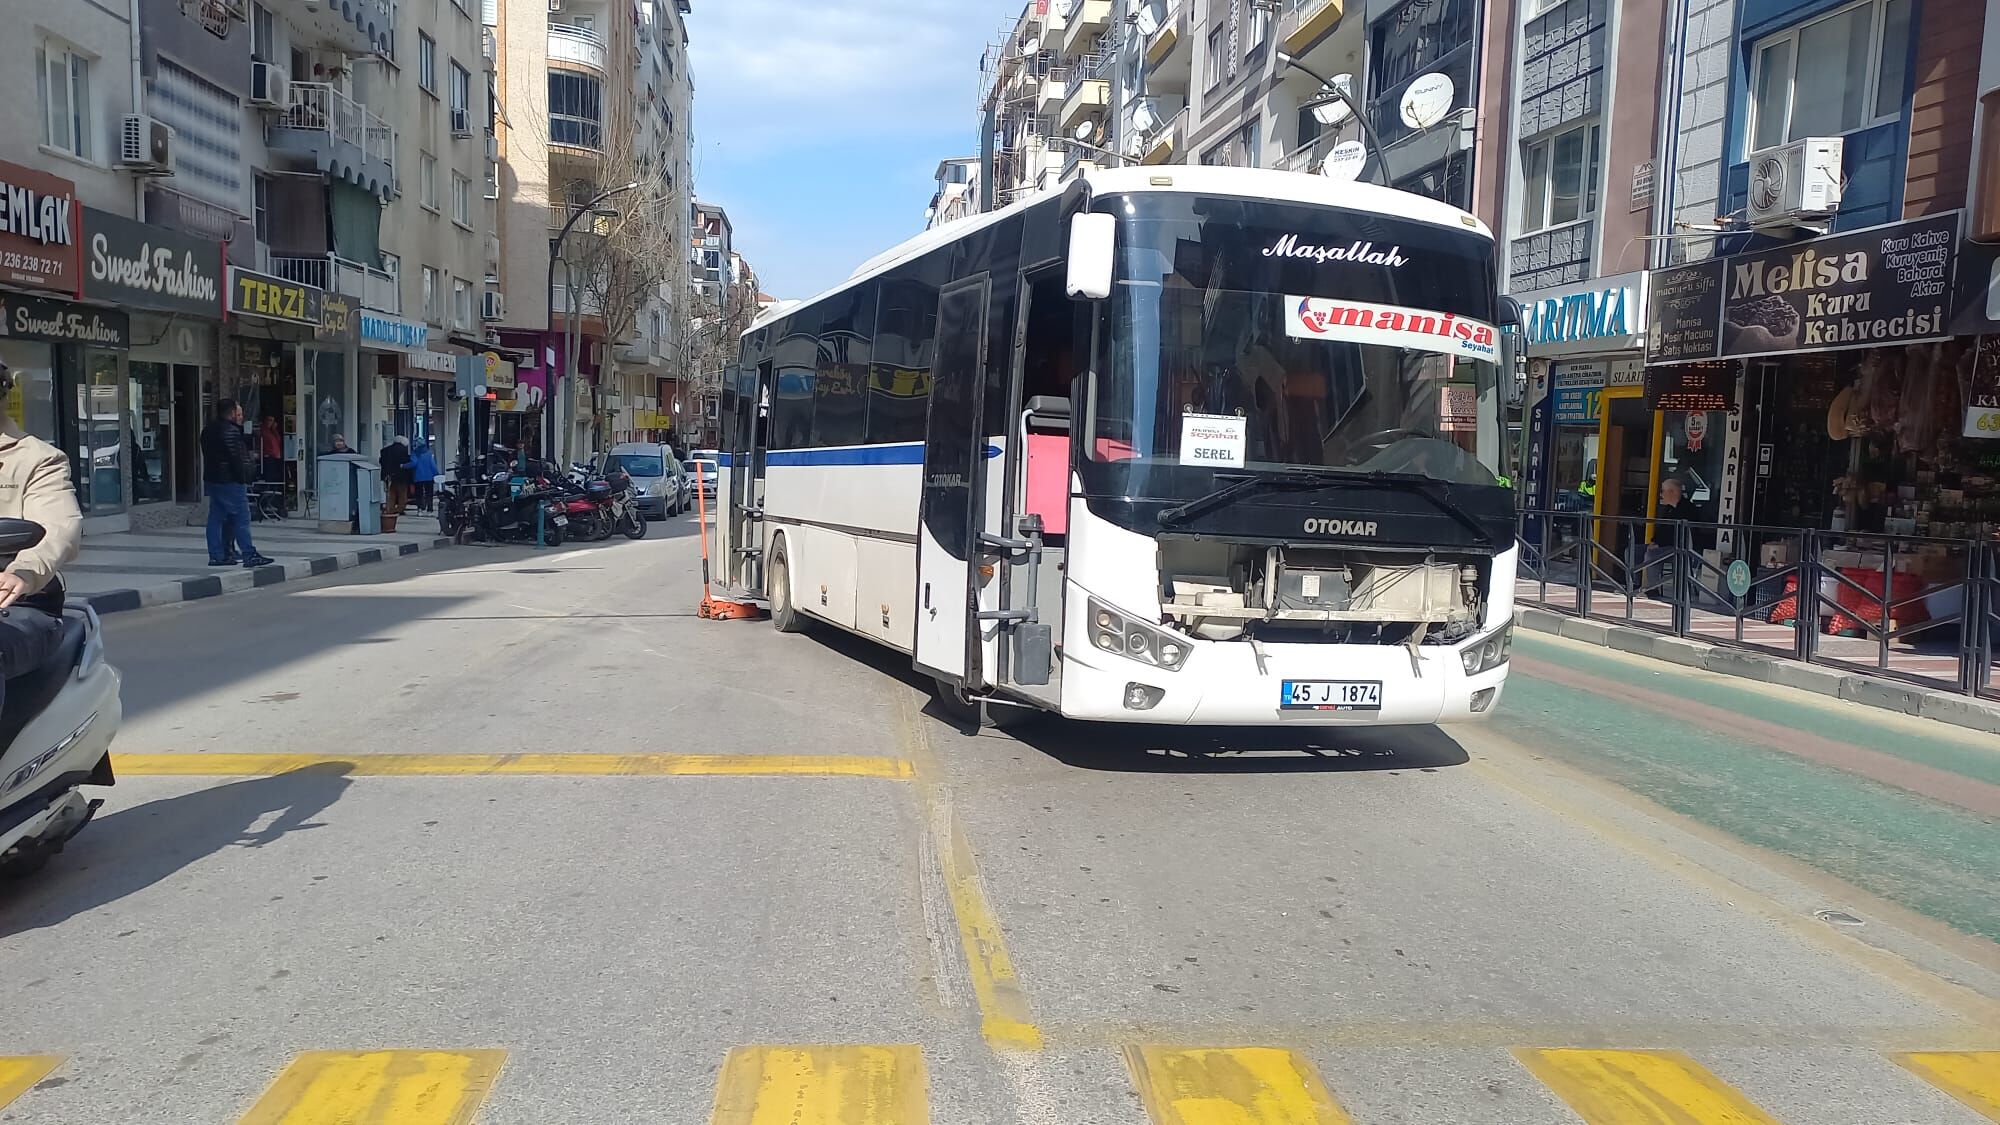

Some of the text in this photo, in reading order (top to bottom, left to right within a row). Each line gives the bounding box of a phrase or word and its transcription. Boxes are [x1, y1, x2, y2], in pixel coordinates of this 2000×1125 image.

[1414, 83, 1444, 95] SUNNY
[1262, 233, 1410, 267] Maşallah
[1881, 230, 1950, 254] Kuru Kahve
[4, 251, 21, 269] 236
[22, 255, 39, 272] 238
[40, 258, 51, 274] 72
[52, 260, 63, 276] 71
[92, 233, 216, 301] Sweet Fashion
[1886, 247, 1948, 270] Kuruyemiş
[1730, 249, 1868, 299] Melisa
[1897, 263, 1945, 283] Baharat
[1910, 281, 1945, 298] Aktar
[1805, 291, 1872, 318] Kuru
[15, 306, 120, 344] Sweet Fashion
[1326, 303, 1494, 346] manisa
[1528, 286, 1632, 345] ARITMA
[1676, 316, 1702, 328] Manisa
[1803, 305, 1942, 345] Kahvecisi
[1663, 329, 1713, 343] Mesir Macunu
[1461, 340, 1494, 355] Seyahat
[1663, 342, 1712, 356] Satış Noktası
[1613, 371, 1625, 384] SU
[1190, 432, 1239, 440] seyahat
[1194, 448, 1234, 461] SEREL
[934, 473, 961, 487] OTOKAR
[1303, 518, 1378, 537] OTOKAR
[1292, 685, 1377, 703] 45 J 1874
